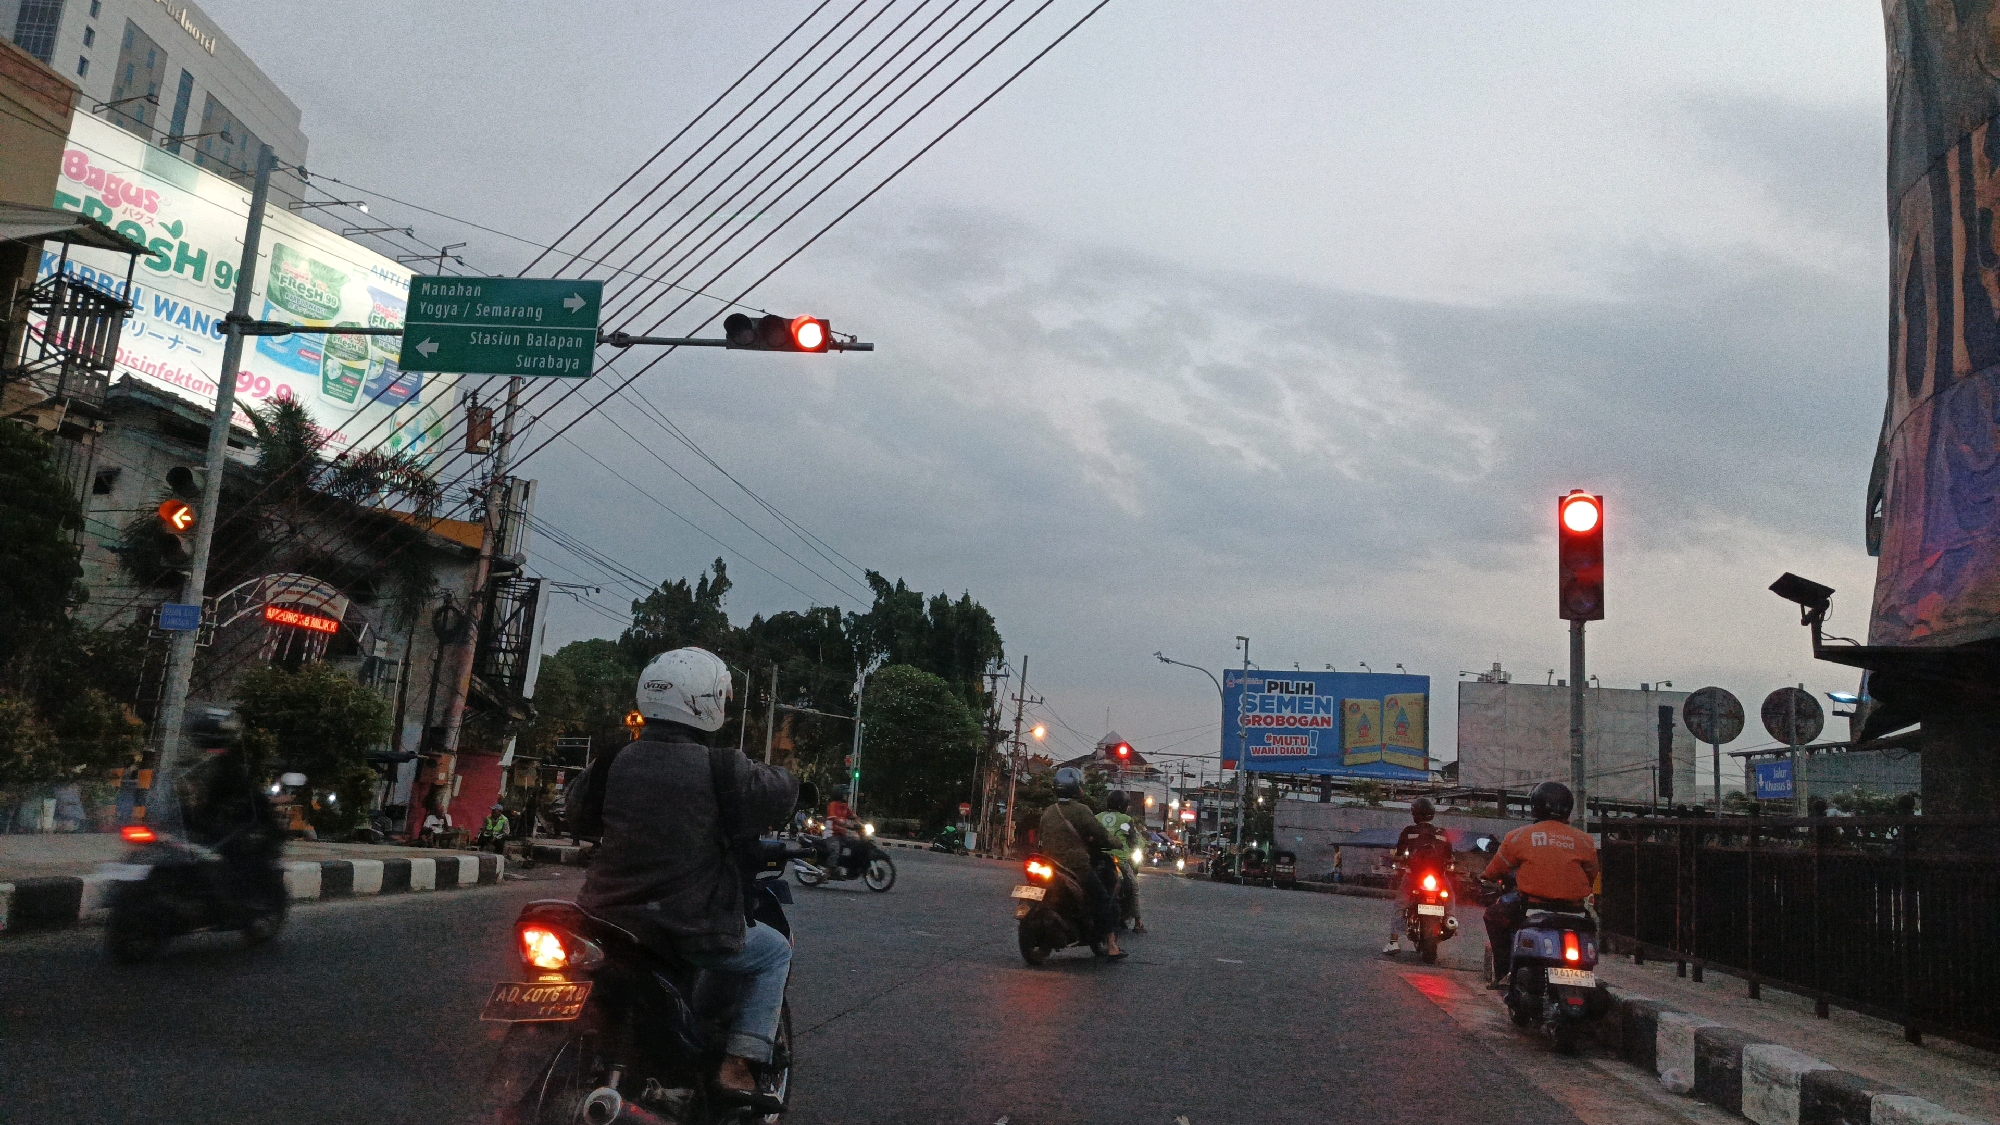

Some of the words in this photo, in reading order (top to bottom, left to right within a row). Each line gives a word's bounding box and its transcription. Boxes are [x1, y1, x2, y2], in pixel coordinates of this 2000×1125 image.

[64, 150, 160, 214] Bagus
[122, 207, 155, 227] バグス
[422, 283, 481, 297] Manahan
[420, 302, 458, 318] Yogya
[463, 303, 471, 317] /
[475, 303, 543, 322] Semarang
[470, 332, 520, 346] Stasiun
[527, 333, 582, 350] Balapan
[115, 347, 215, 395] Disinfektan
[516, 355, 580, 372] Surabaya
[1266, 680, 1314, 695] PILIH
[1241, 693, 1333, 715] SEMEN
[1240, 715, 1332, 728] GROBOGAN
[1265, 733, 1308, 746] #MUTU
[1251, 746, 1278, 755] WANI
[1279, 747, 1308, 755] DIADU
[1773, 766, 1786, 779] Jalur
[1765, 780, 1785, 791] Khusus
[1549, 838, 1574, 849] Food
